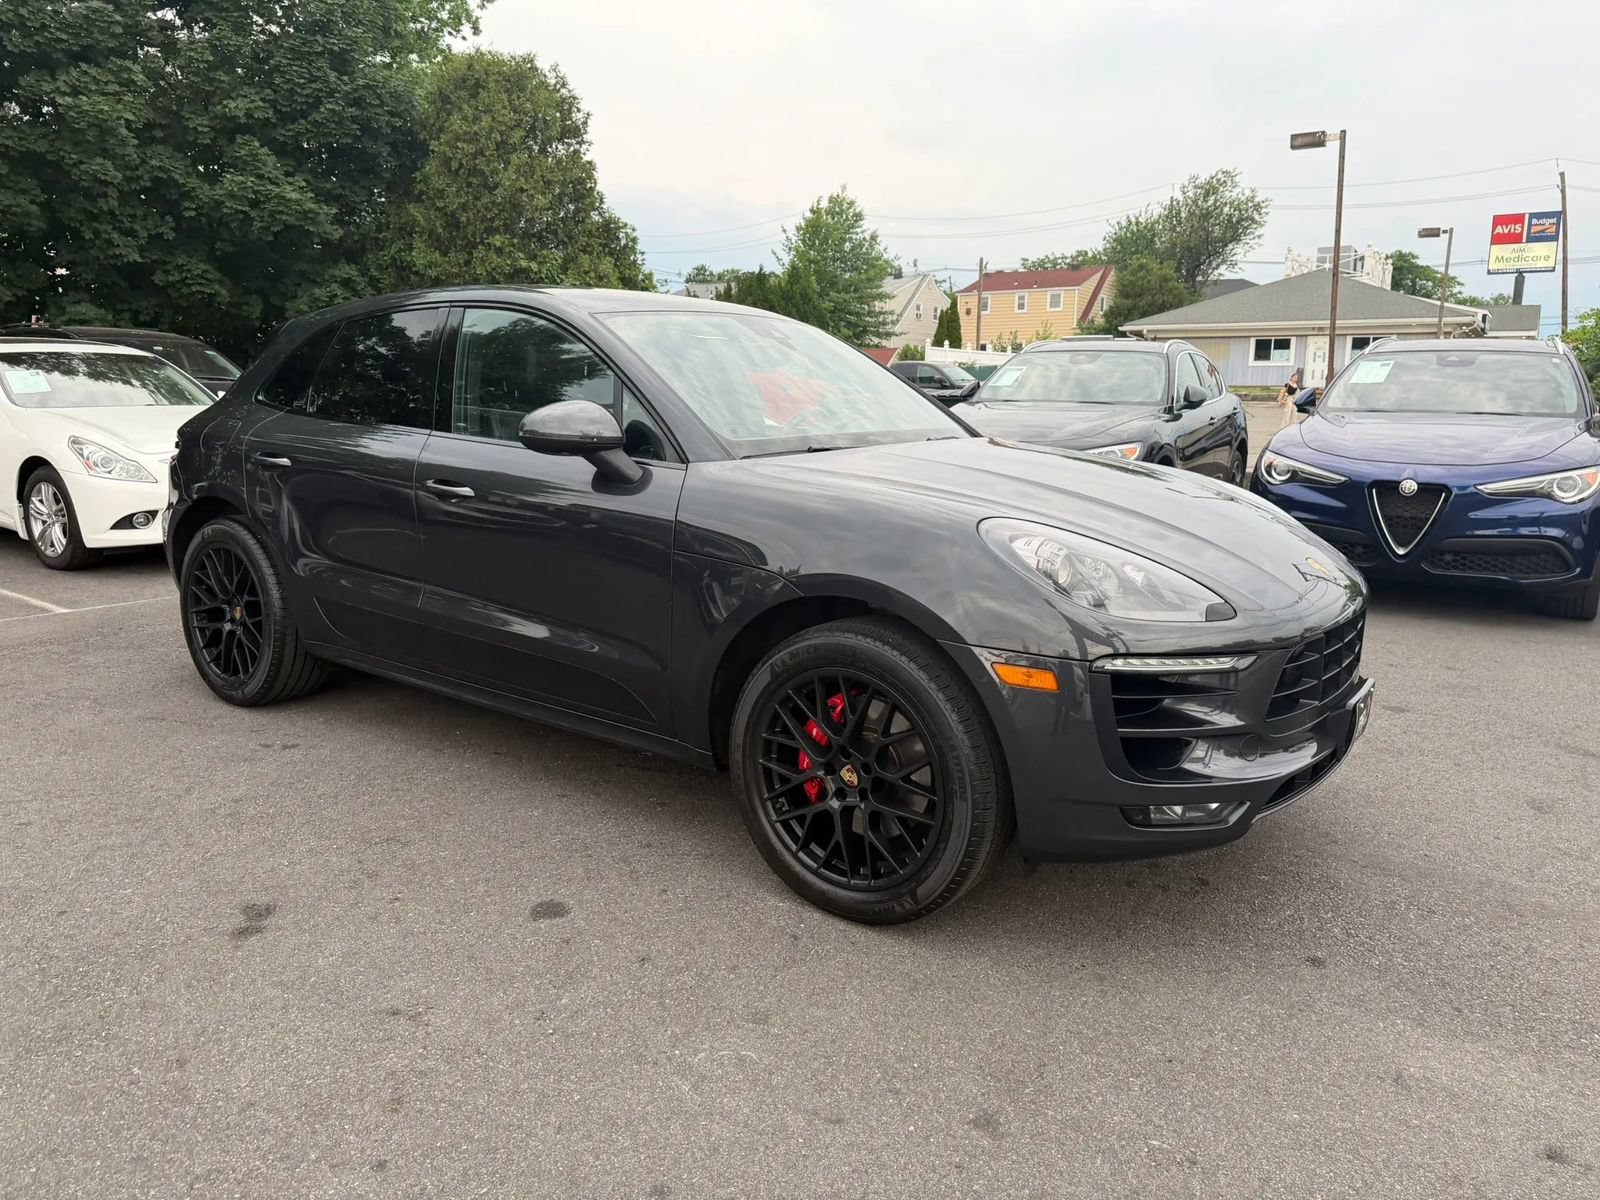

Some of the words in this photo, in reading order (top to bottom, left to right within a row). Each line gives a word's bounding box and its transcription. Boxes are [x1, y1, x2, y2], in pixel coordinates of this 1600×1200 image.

[1532, 217, 1557, 225] Budget
[1494, 224, 1522, 234] AVIS
[1495, 254, 1551, 264] Medicare
